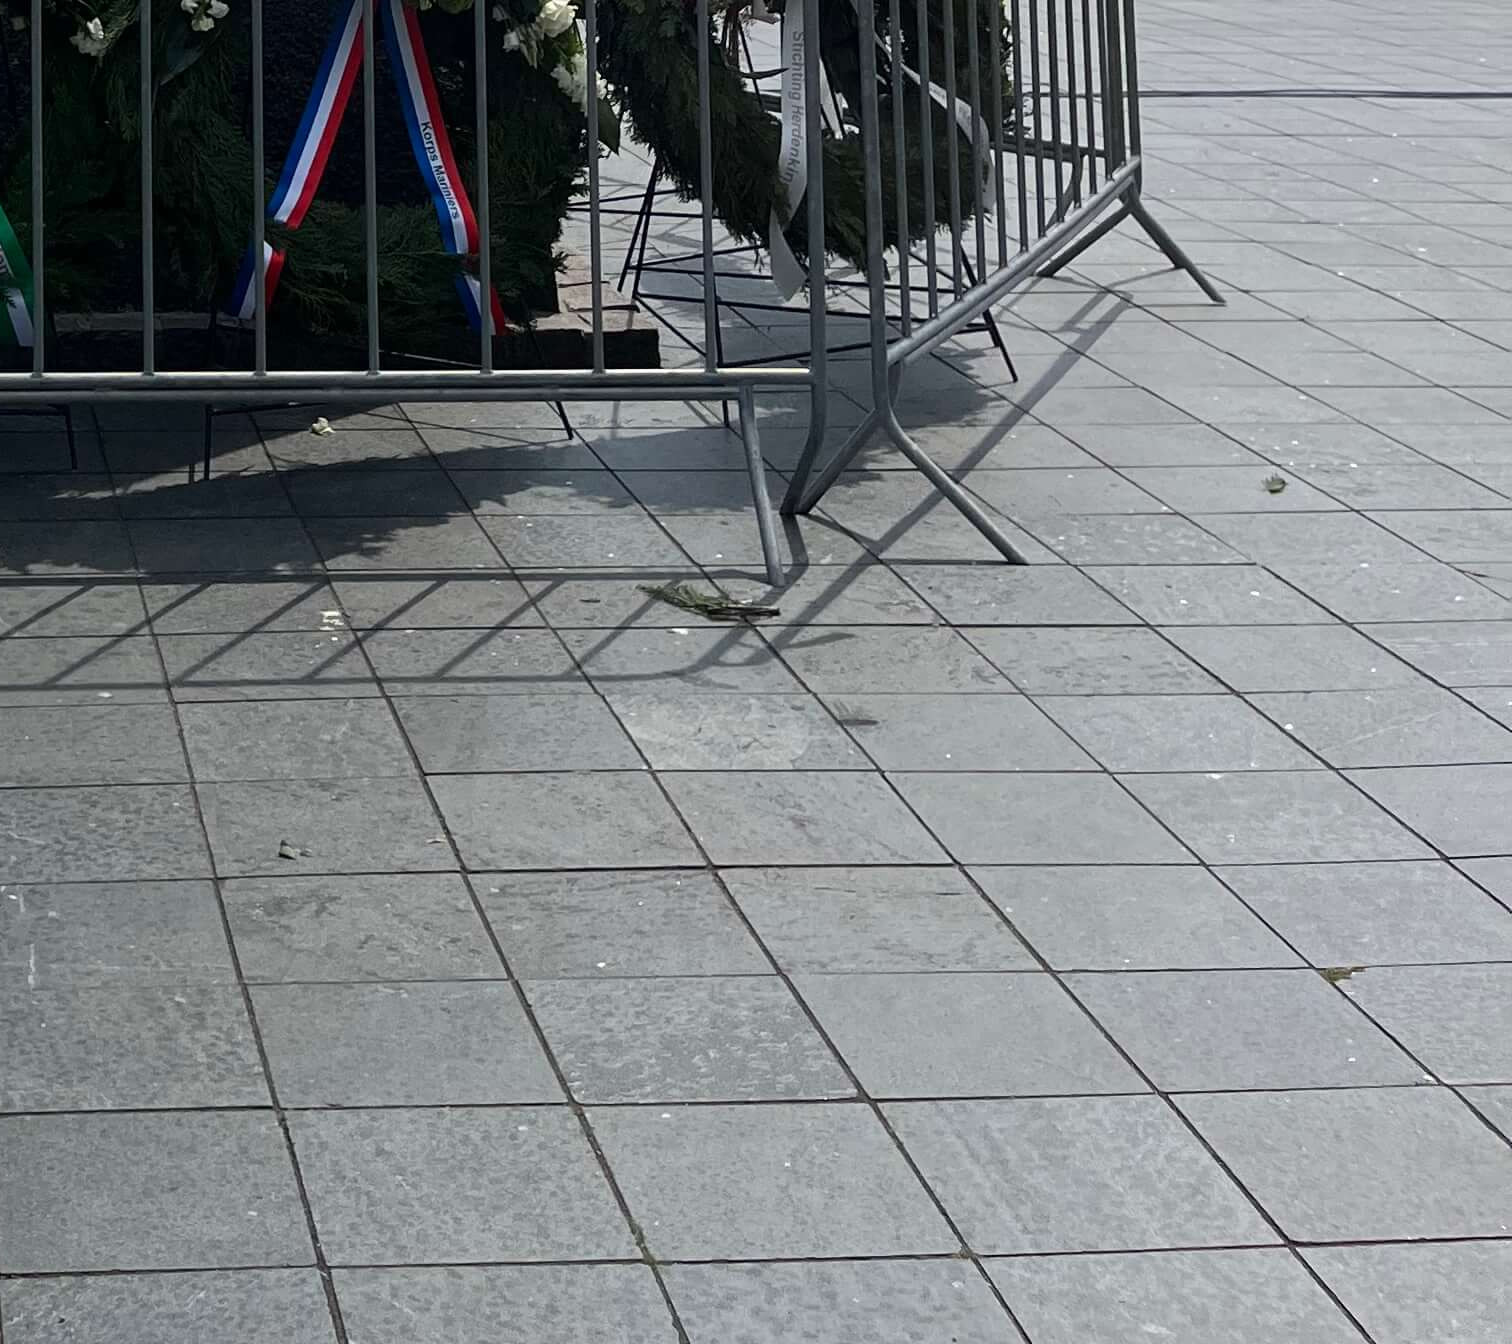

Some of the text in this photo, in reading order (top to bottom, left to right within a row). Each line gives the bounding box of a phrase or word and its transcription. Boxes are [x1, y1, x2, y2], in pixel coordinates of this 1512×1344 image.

[421, 120, 460, 219] Korps Mariniers
[782, 31, 806, 185] Stichting Herdenkin
